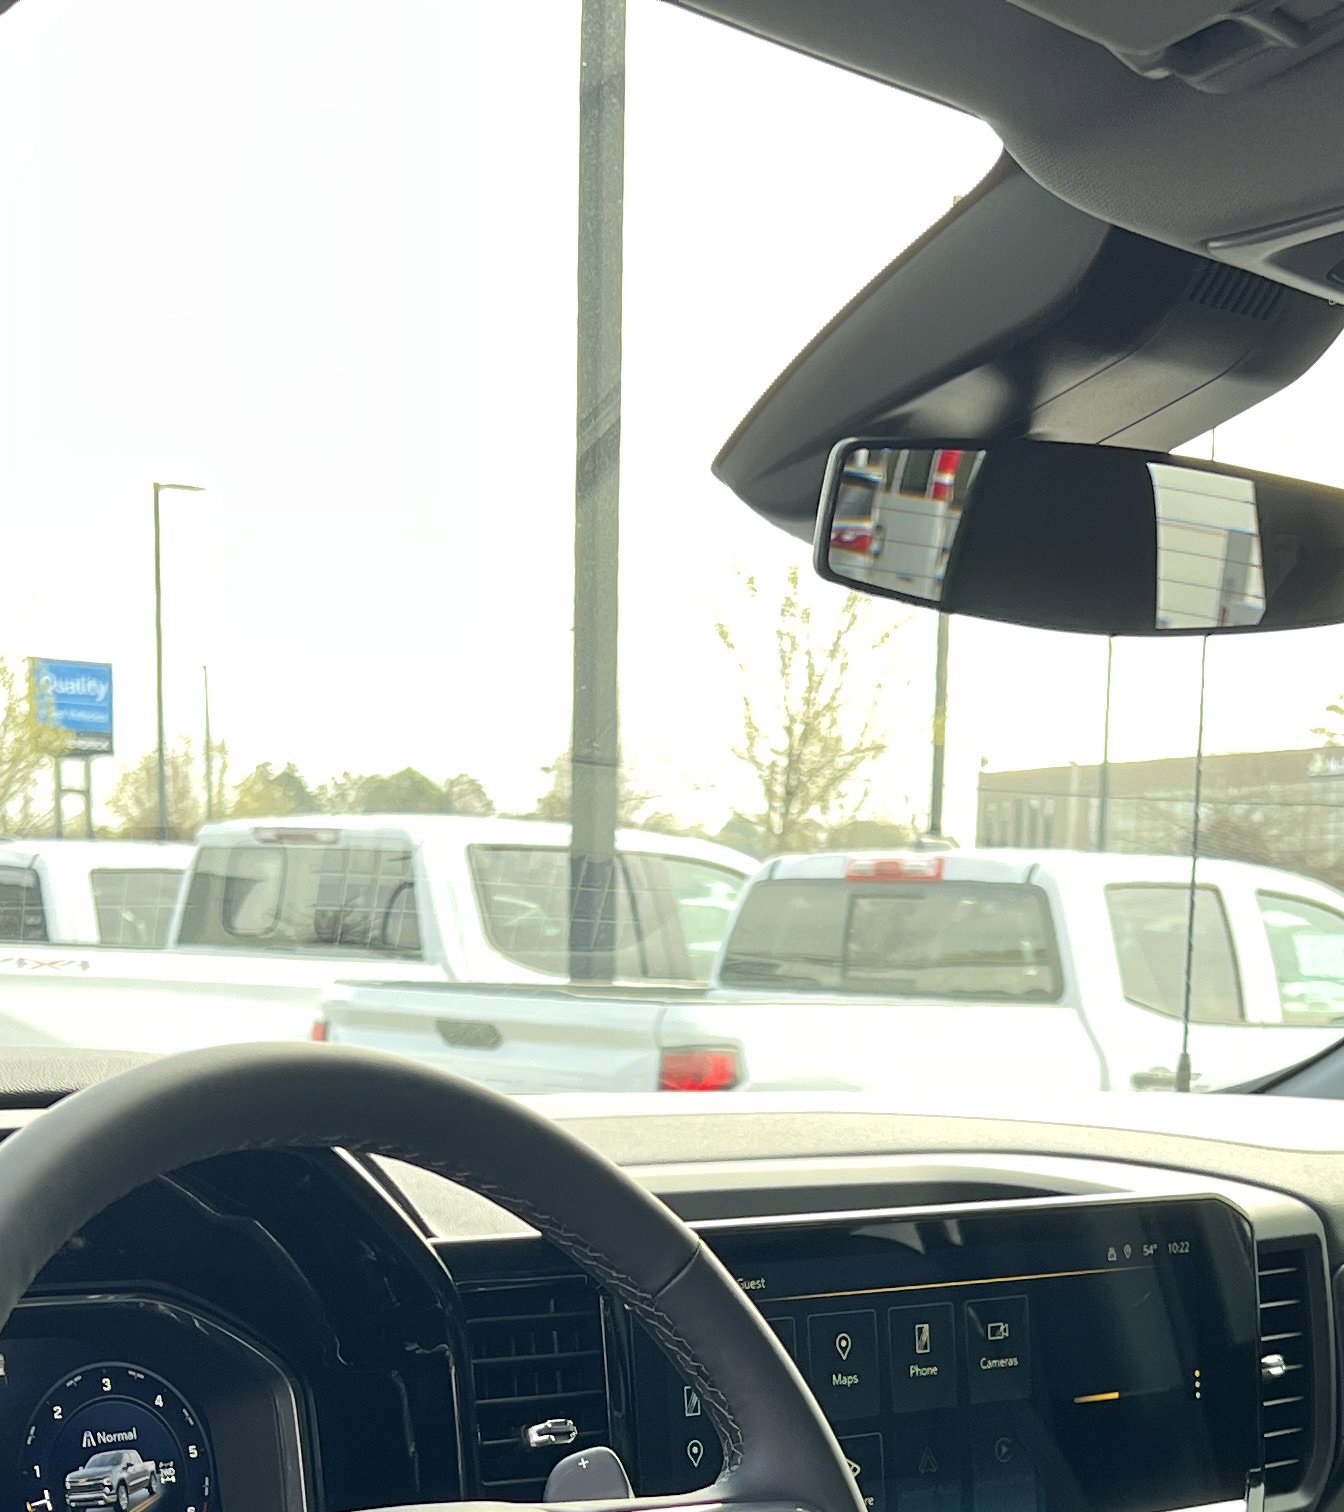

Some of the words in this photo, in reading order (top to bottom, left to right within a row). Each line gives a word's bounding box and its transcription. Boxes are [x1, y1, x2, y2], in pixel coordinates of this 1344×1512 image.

[37, 675, 109, 702] Quality
[1167, 1242, 1190, 1255] 10:22
[979, 1356, 1019, 1370] Cameras
[909, 1364, 938, 1377] Phone
[102, 1377, 112, 1391] 3
[832, 1372, 859, 1388] Maps
[154, 1394, 164, 1408] 4
[53, 1406, 63, 1420] 2
[96, 1427, 137, 1445] Normal
[188, 1445, 198, 1458] 5
[33, 1464, 41, 1478] 1
